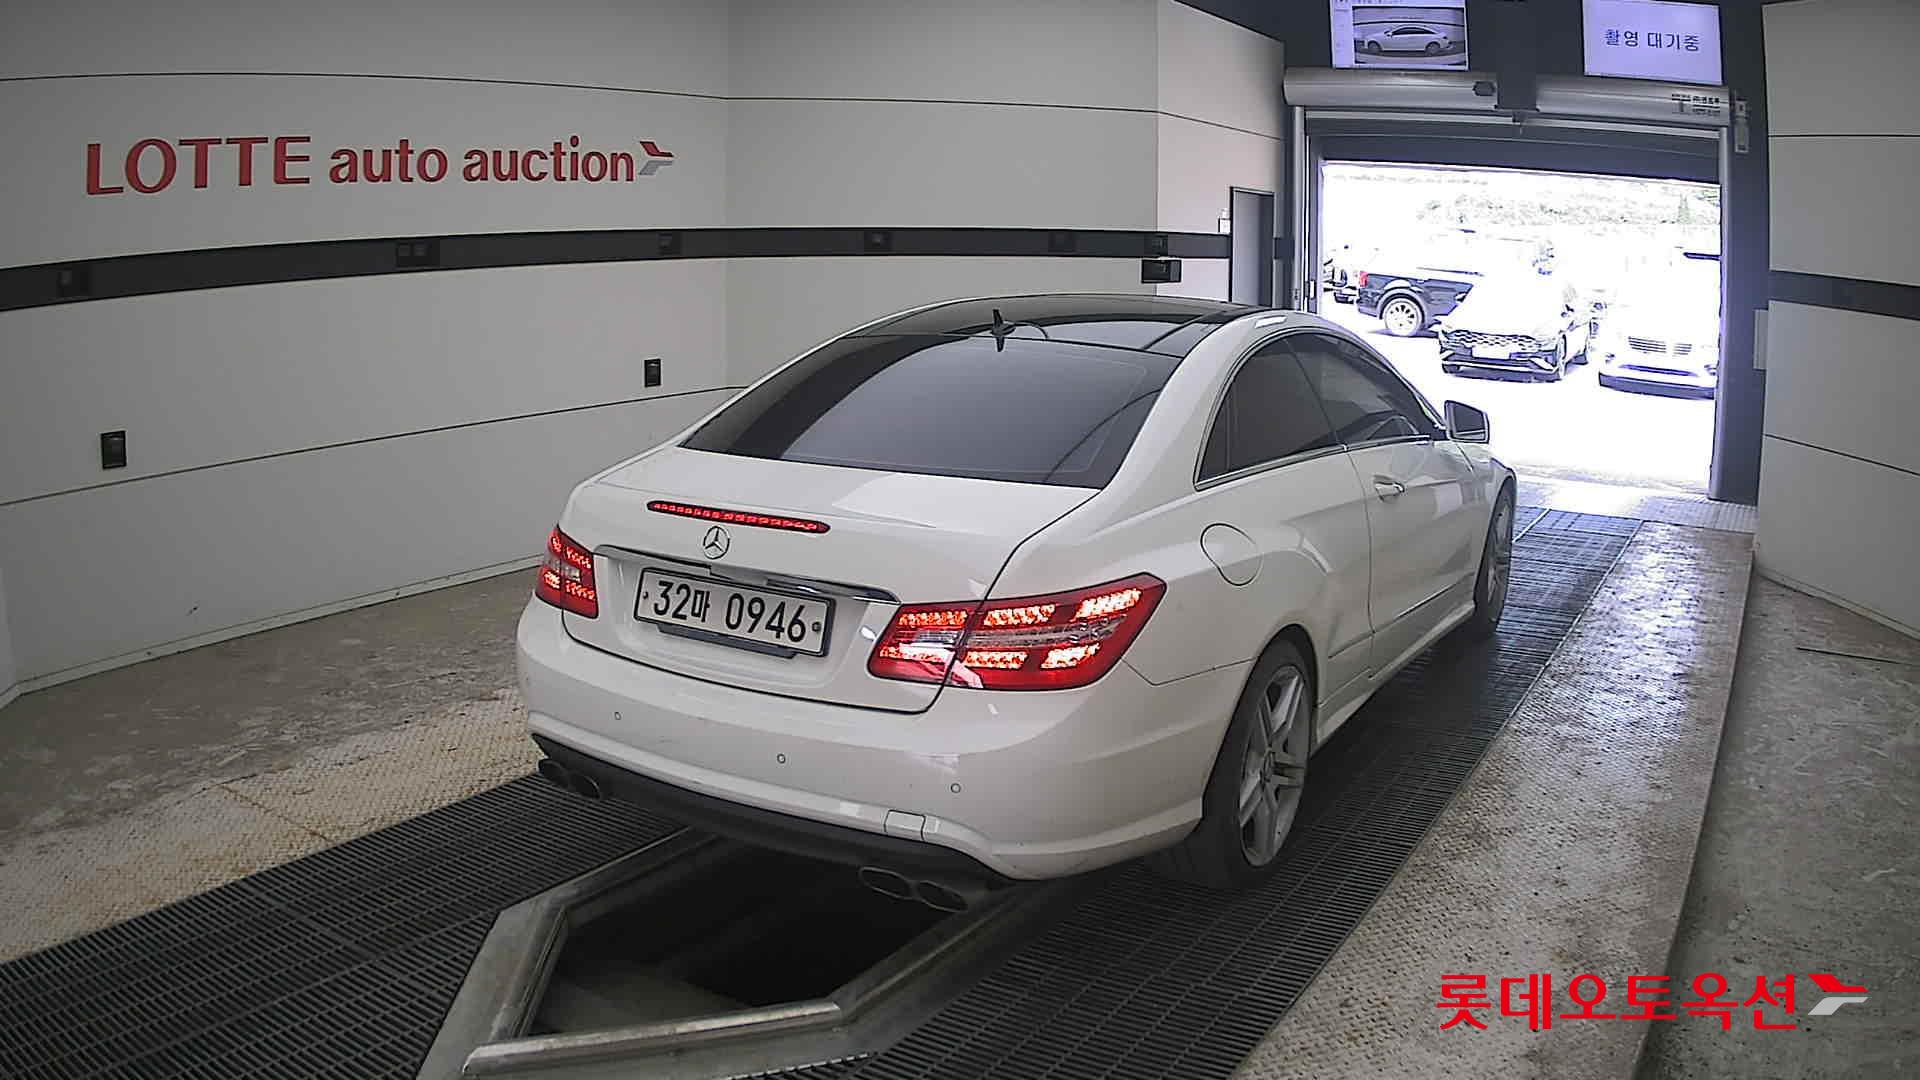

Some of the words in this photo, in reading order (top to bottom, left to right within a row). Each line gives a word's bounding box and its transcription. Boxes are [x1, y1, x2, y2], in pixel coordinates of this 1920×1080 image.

[1604, 28, 1639, 48] 촬영
[1646, 31, 1700, 52] 대기중
[87, 136, 310, 195] LOTTE
[329, 139, 448, 183] auto
[463, 135, 635, 182] auction
[653, 580, 711, 622] 32마
[725, 592, 806, 642] 0946
